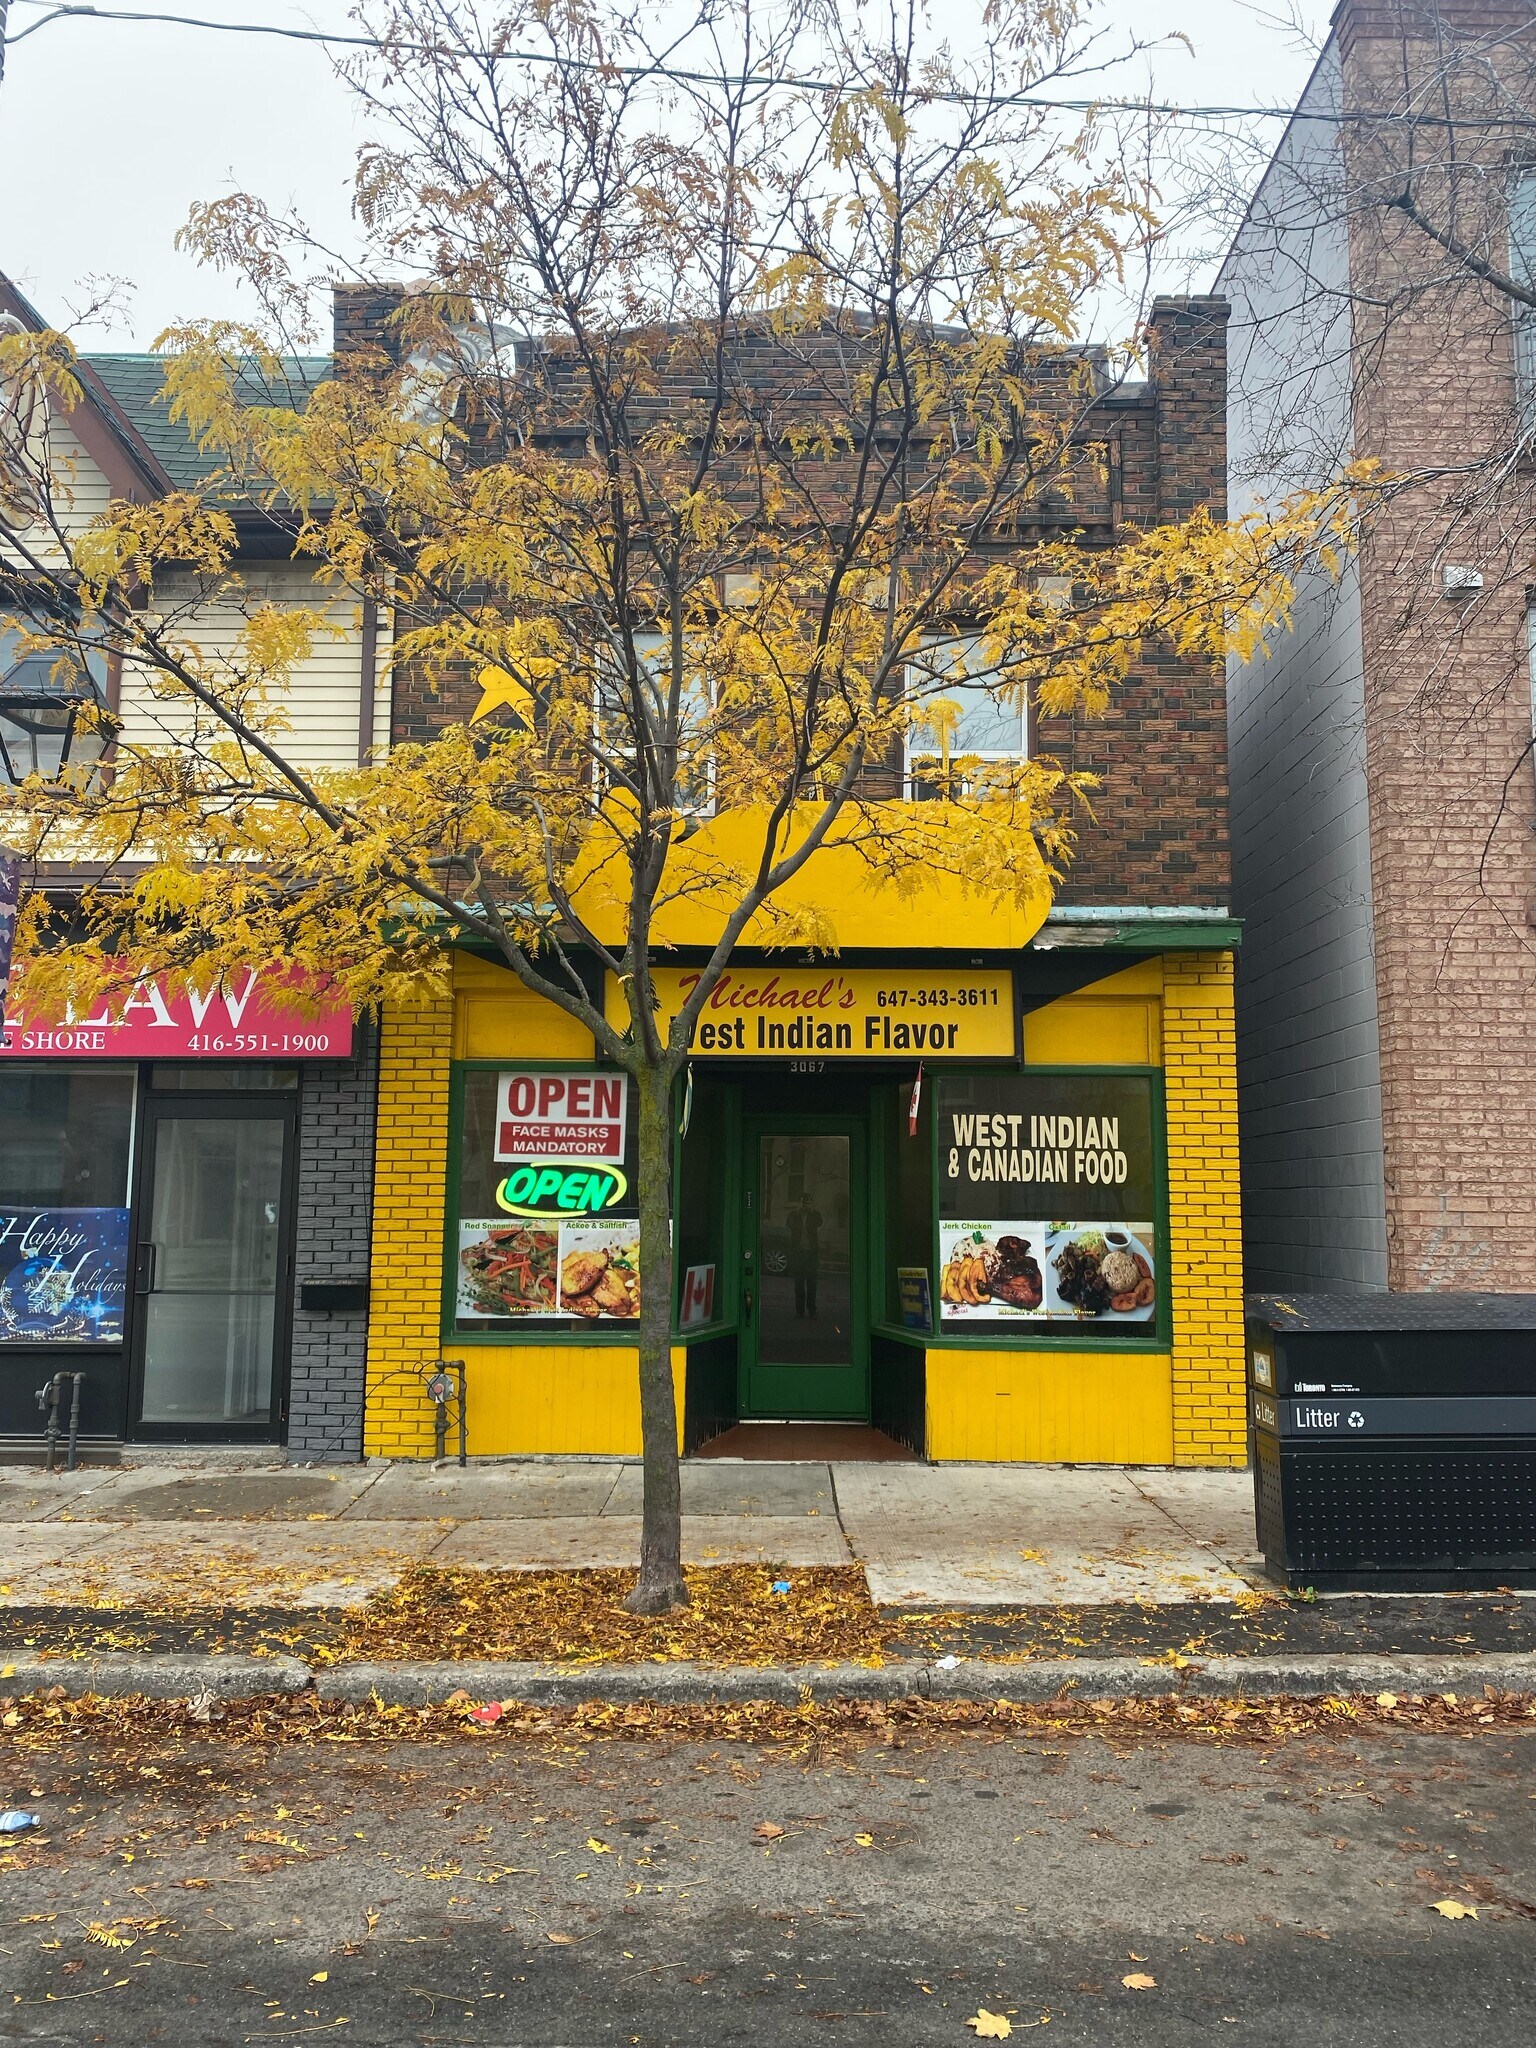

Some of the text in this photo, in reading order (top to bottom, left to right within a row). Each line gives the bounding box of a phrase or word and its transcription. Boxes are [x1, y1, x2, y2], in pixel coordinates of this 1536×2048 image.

[679, 974, 857, 1009] Michael's
[877, 989, 998, 1007] 647-343-3611
[21, 1031, 105, 1050] SHORE
[187, 1034, 329, 1051] 416-551-1900
[758, 1016, 852, 1049] Indian
[865, 1016, 958, 1049] Flavor
[790, 1061, 825, 1073] 3067
[508, 1076, 621, 1119] OPEN
[512, 1125, 609, 1139] FACE MASKS
[952, 1114, 1119, 1149] WEST INDIAN
[513, 1141, 607, 1154] MANDATORY
[948, 1148, 1128, 1185] & CANADIAN FOOD
[505, 1167, 615, 1212] OPEN
[0, 1212, 88, 1255] Happy
[464, 1222, 480, 1230] Red
[565, 1222, 590, 1230] Ackee
[591, 1222, 597, 1230] &
[28, 1249, 126, 1304] Holidays
[1261, 1401, 1275, 1426] Litter
[1296, 1407, 1340, 1428] Litter
